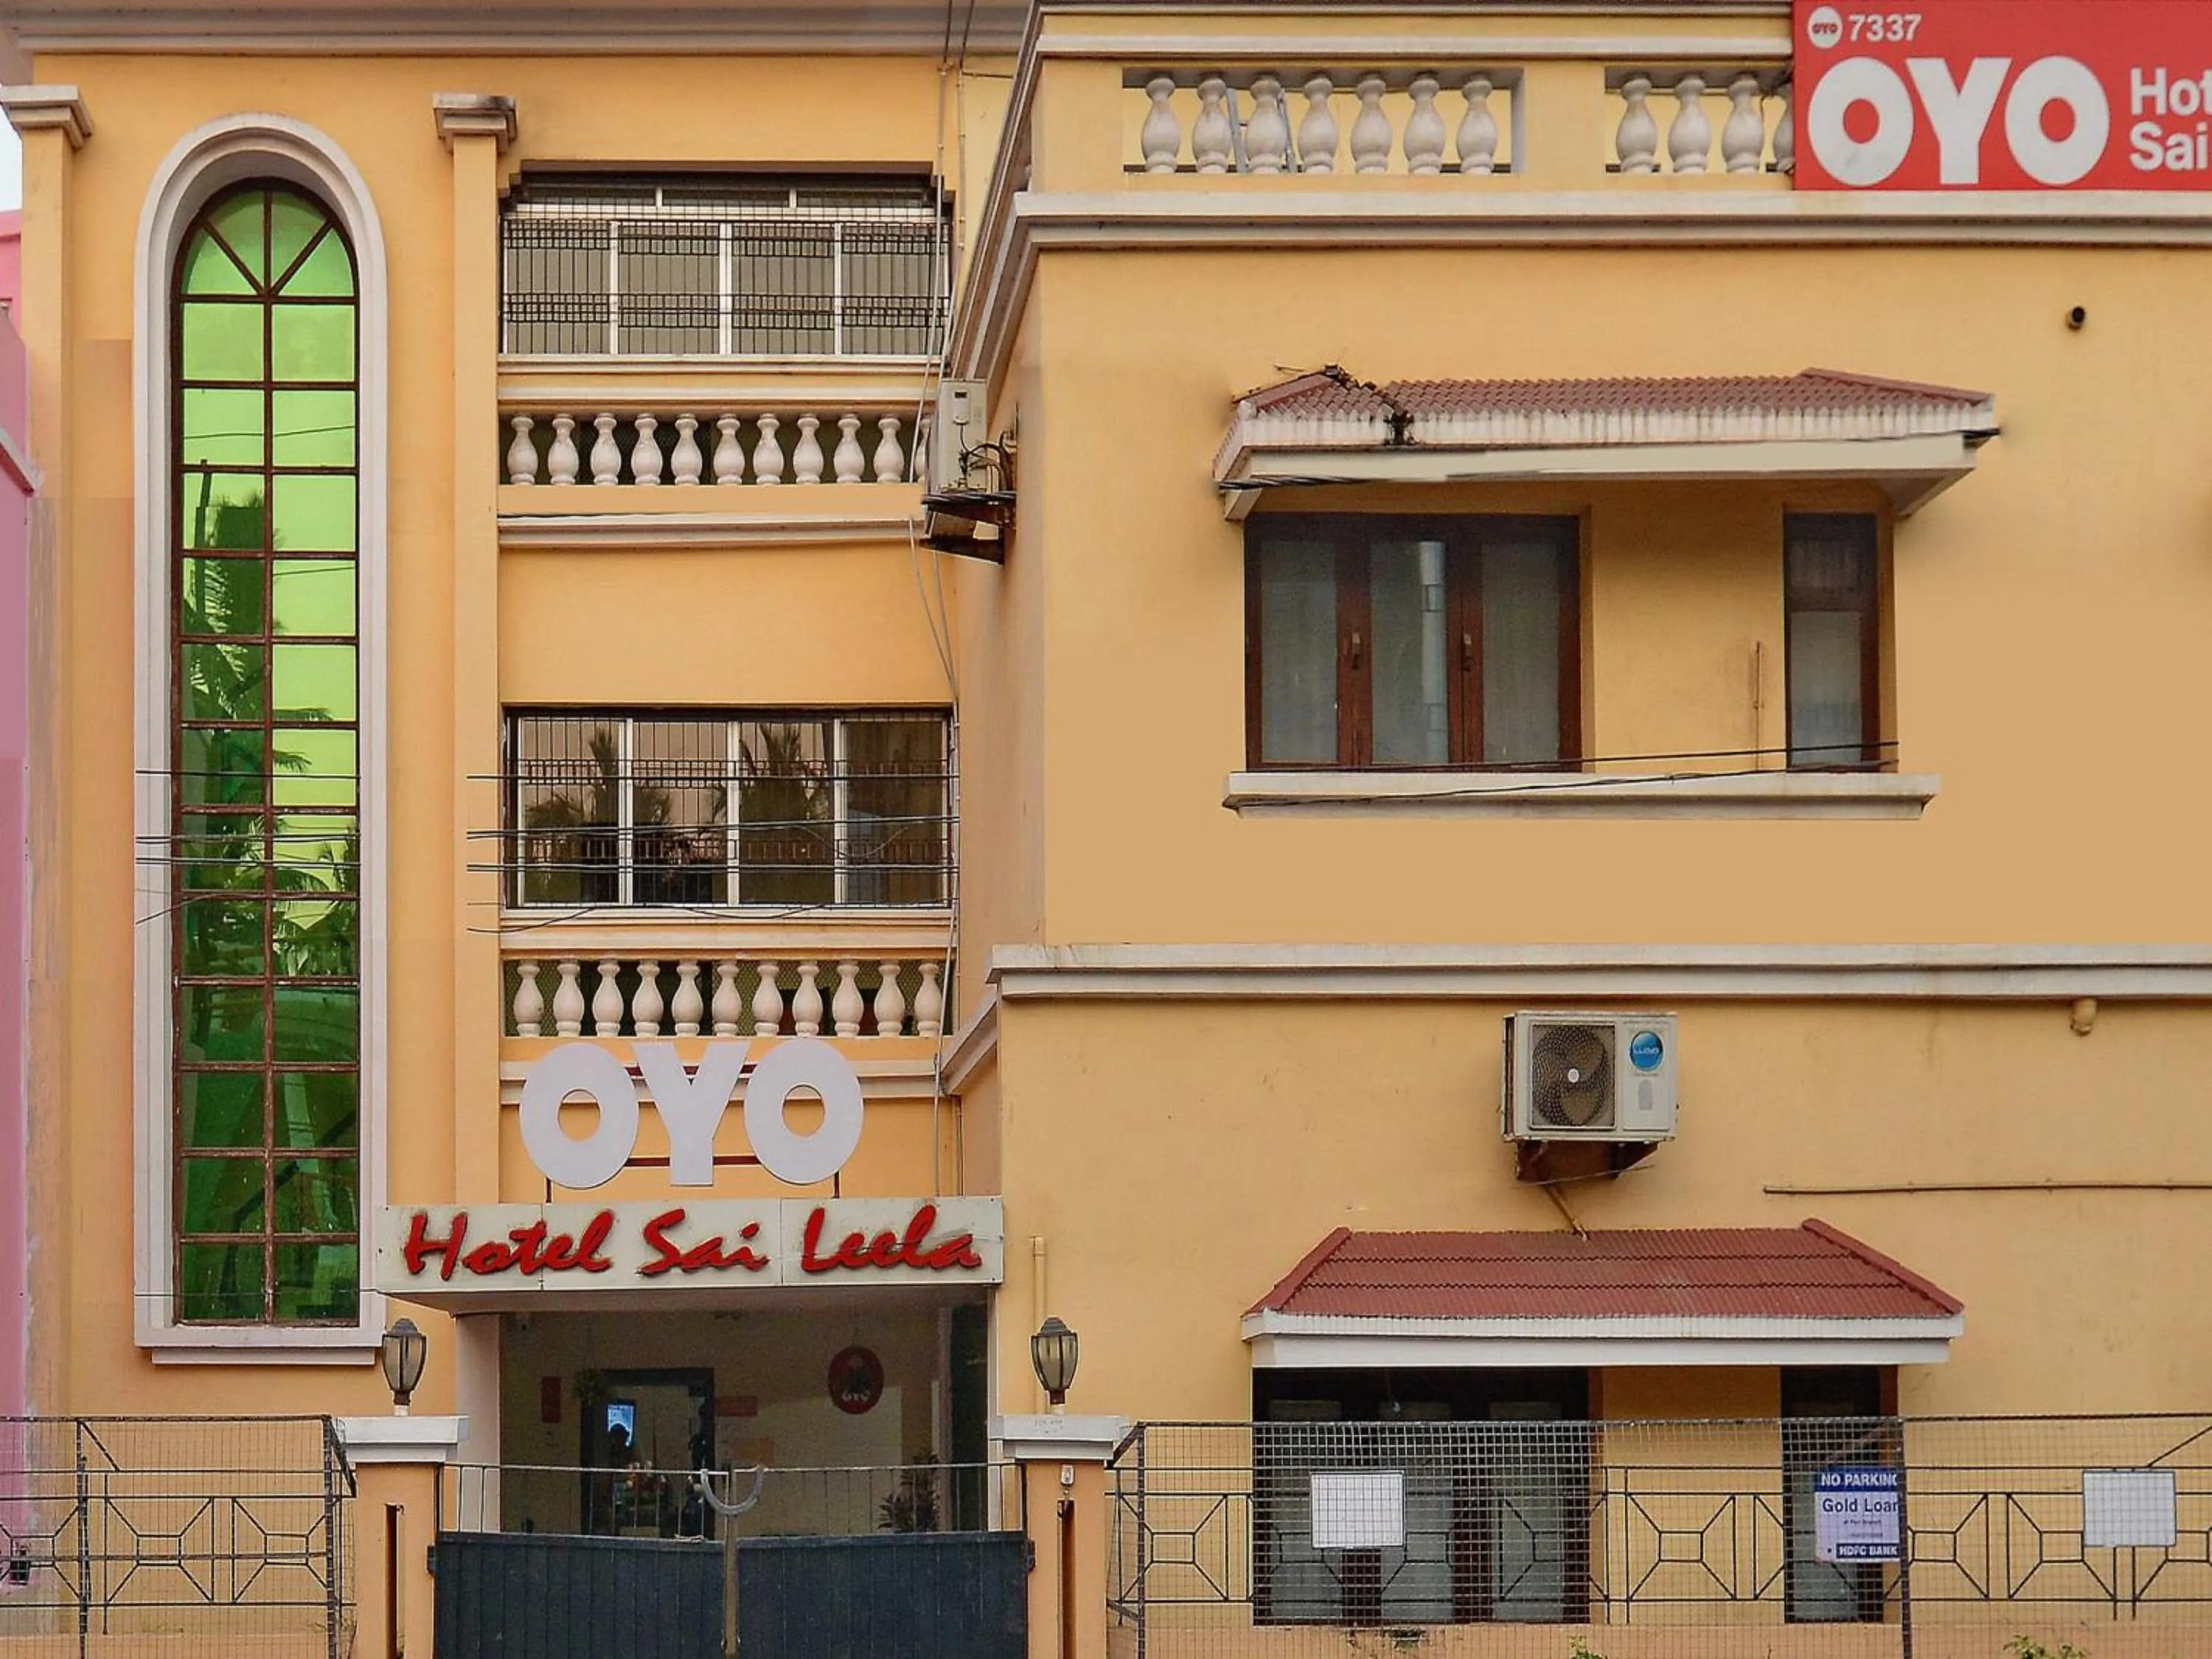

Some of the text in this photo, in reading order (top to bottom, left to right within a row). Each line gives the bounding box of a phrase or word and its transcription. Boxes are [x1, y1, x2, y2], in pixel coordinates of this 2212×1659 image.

[1812, 13, 1922, 42] OYO 7337
[1808, 56, 2110, 186] OYO
[2129, 121, 2208, 171] Sai
[519, 1038, 864, 1189] OYO
[403, 1203, 984, 1280] Hotel Sai Leela
[1821, 1474, 1841, 1486] NO
[1823, 1498, 1858, 1512] Gold
